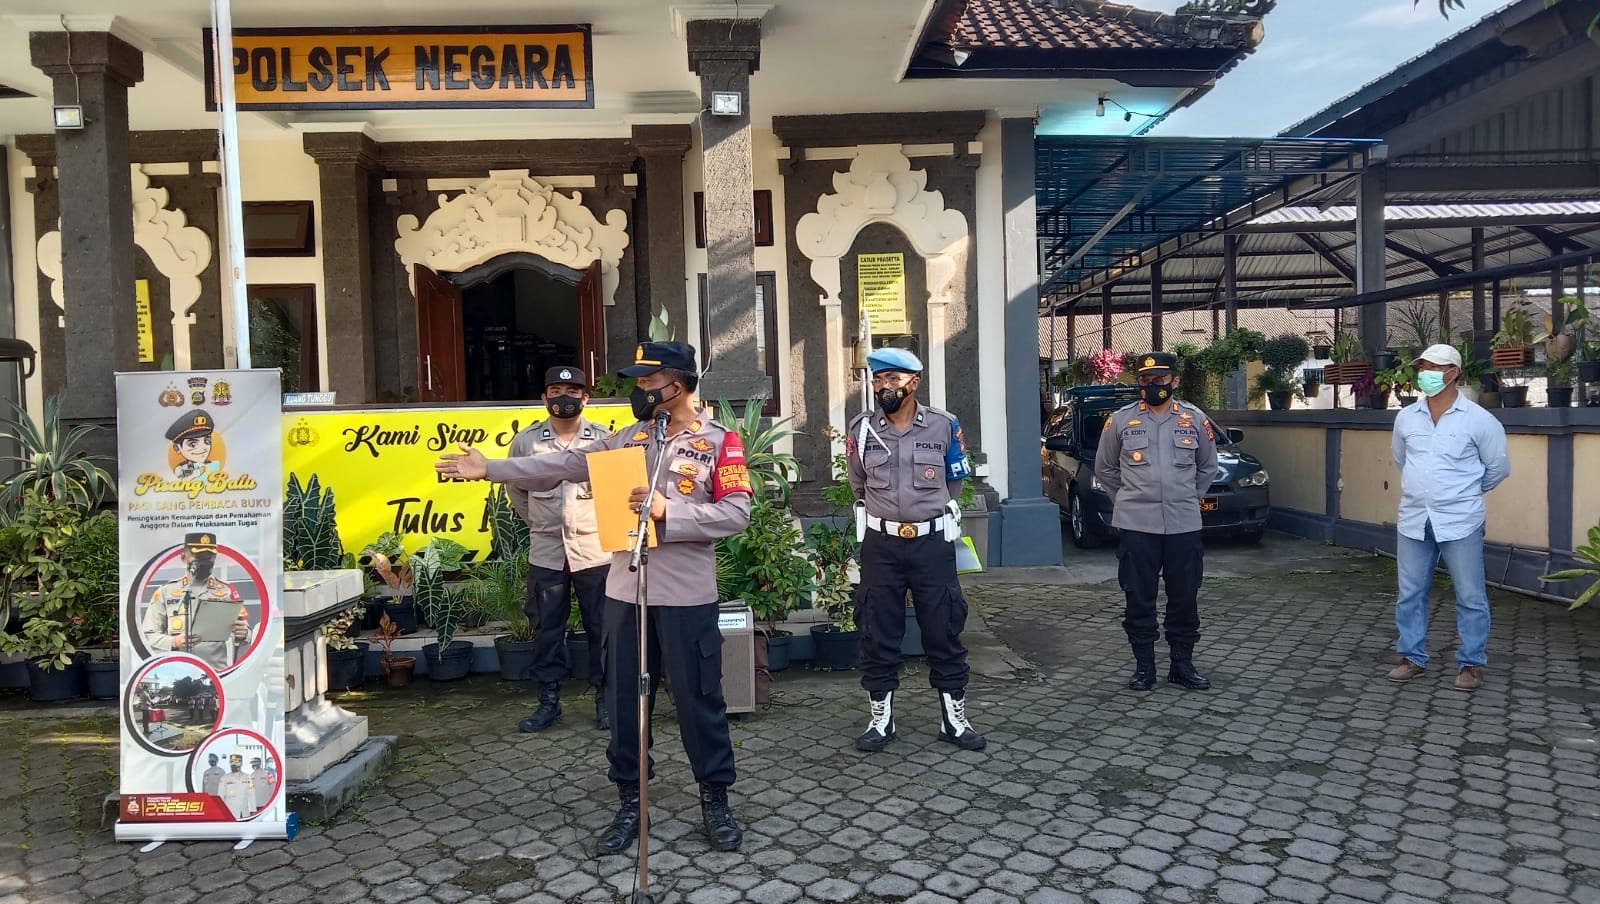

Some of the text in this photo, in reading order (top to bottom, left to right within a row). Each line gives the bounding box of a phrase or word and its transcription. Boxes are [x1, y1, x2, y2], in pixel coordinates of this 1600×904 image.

[232, 44, 576, 92] POLSEK NEGARA
[342, 424, 421, 458] Kami
[427, 422, 489, 451] Siap
[915, 442, 941, 450] POLRI
[677, 447, 712, 465] POLRI
[134, 472, 204, 499] Pisang
[155, 501, 186, 511] SANG
[189, 500, 238, 511] PEMBACA
[241, 499, 271, 508] BUKU
[171, 514, 213, 522] Kemampuan
[386, 497, 465, 536] Tulus
[145, 801, 204, 812] PRESISI
